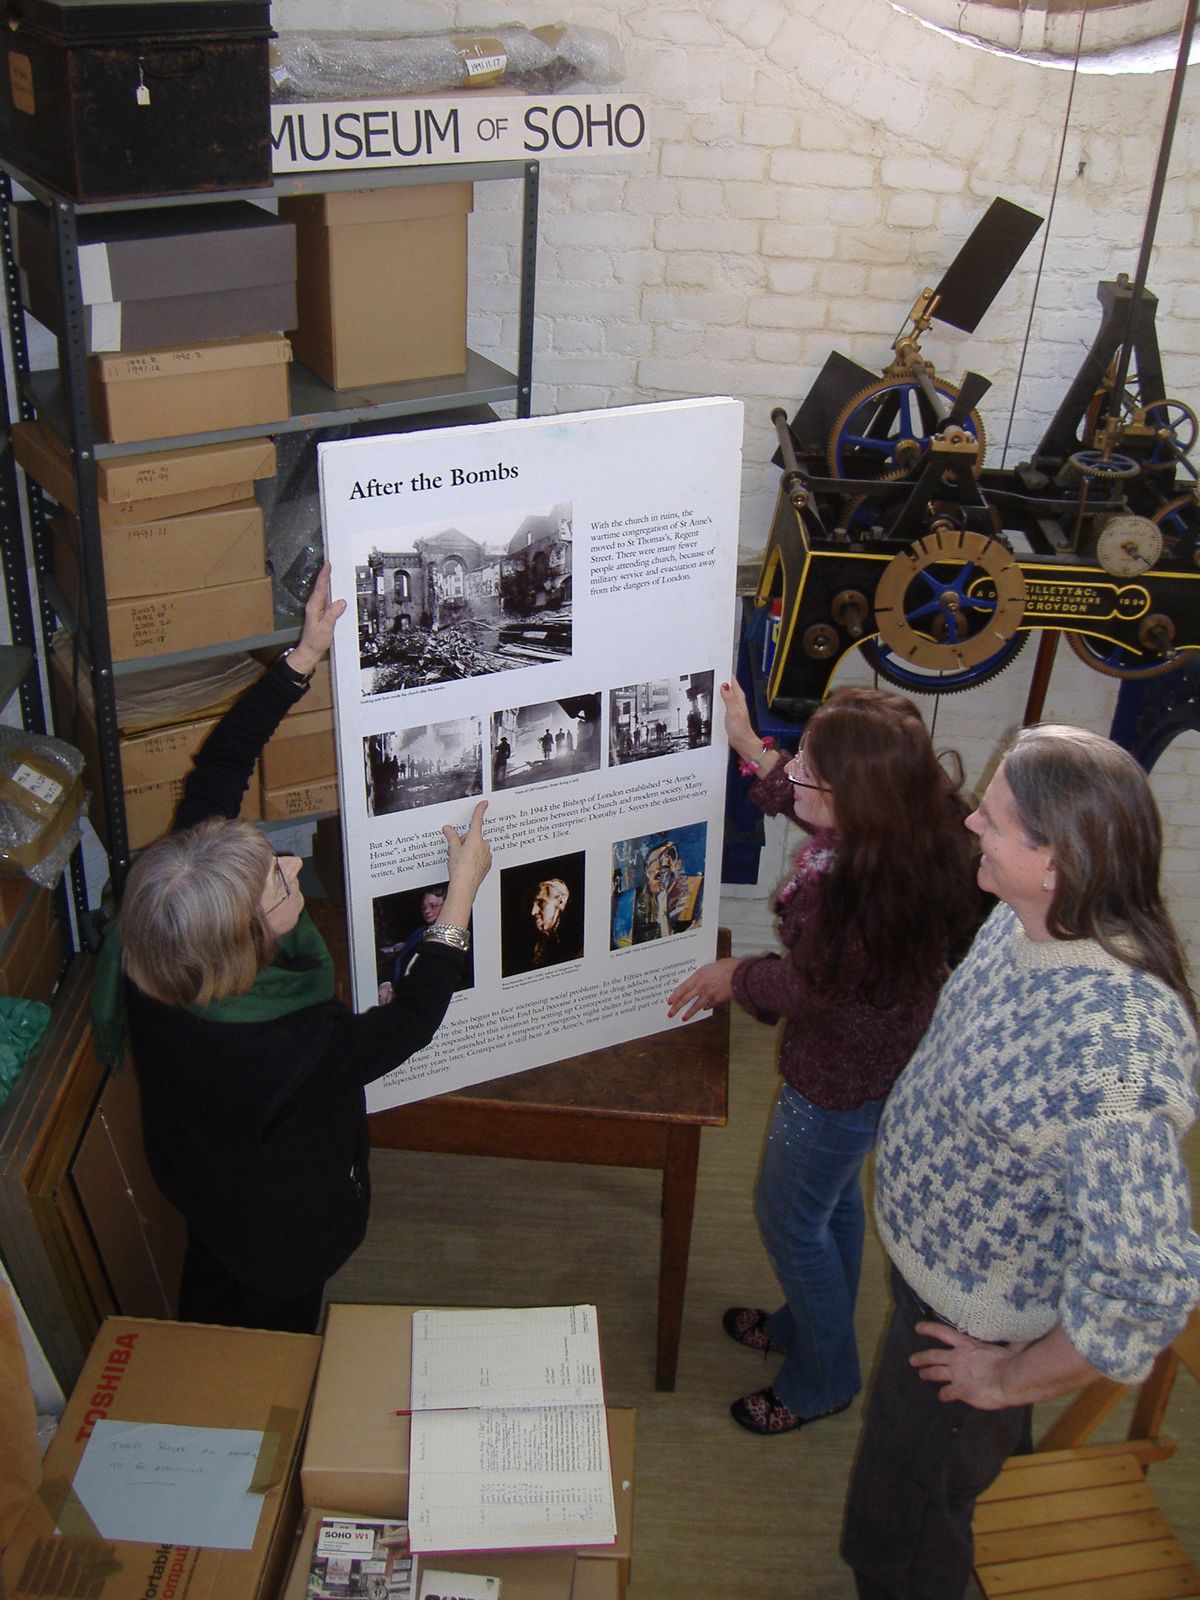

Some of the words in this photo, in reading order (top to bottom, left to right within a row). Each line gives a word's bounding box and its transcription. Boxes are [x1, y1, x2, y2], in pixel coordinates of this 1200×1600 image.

[271, 108, 460, 161] MUSEUM
[477, 118, 508, 141] OF
[524, 104, 645, 151] SOHO
[349, 479, 403, 500] After
[411, 473, 442, 491] the
[450, 463, 518, 486] Bombs
[591, 521, 609, 530] With
[612, 519, 622, 527] the
[625, 515, 648, 525] church
[661, 512, 680, 520] ruins,
[591, 531, 620, 541] wartime
[622, 524, 668, 536] congregation
[670, 521, 679, 529] of
[680, 520, 687, 528] St
[689, 516, 712, 526] Anne's
[591, 542, 615, 552] moved
[638, 534, 672, 545] Thomas's,
[675, 531, 699, 541] Regent
[591, 554, 613, 563] Street.
[616, 551, 636, 559] There
[679, 542, 697, 550] fewer
[591, 563, 614, 575] people
[617, 559, 649, 569] attending
[652, 554, 677, 564] church,
[680, 552, 704, 560] because
[707, 548, 716, 556] of
[591, 575, 617, 584] military
[620, 571, 643, 580] service
[646, 567, 658, 576] and
[661, 563, 696, 574] evacuation
[610, 584, 621, 592] the
[624, 582, 650, 590] dangers
[652, 578, 661, 586] of
[662, 575, 691, 584] London.
[1025, 595, 1100, 605] ANUFACTURERS
[1026, 602, 1087, 612] CROYDON
[76, 1332, 139, 1444] TOSHIBA
[325, 1531, 352, 1539] SOHO
